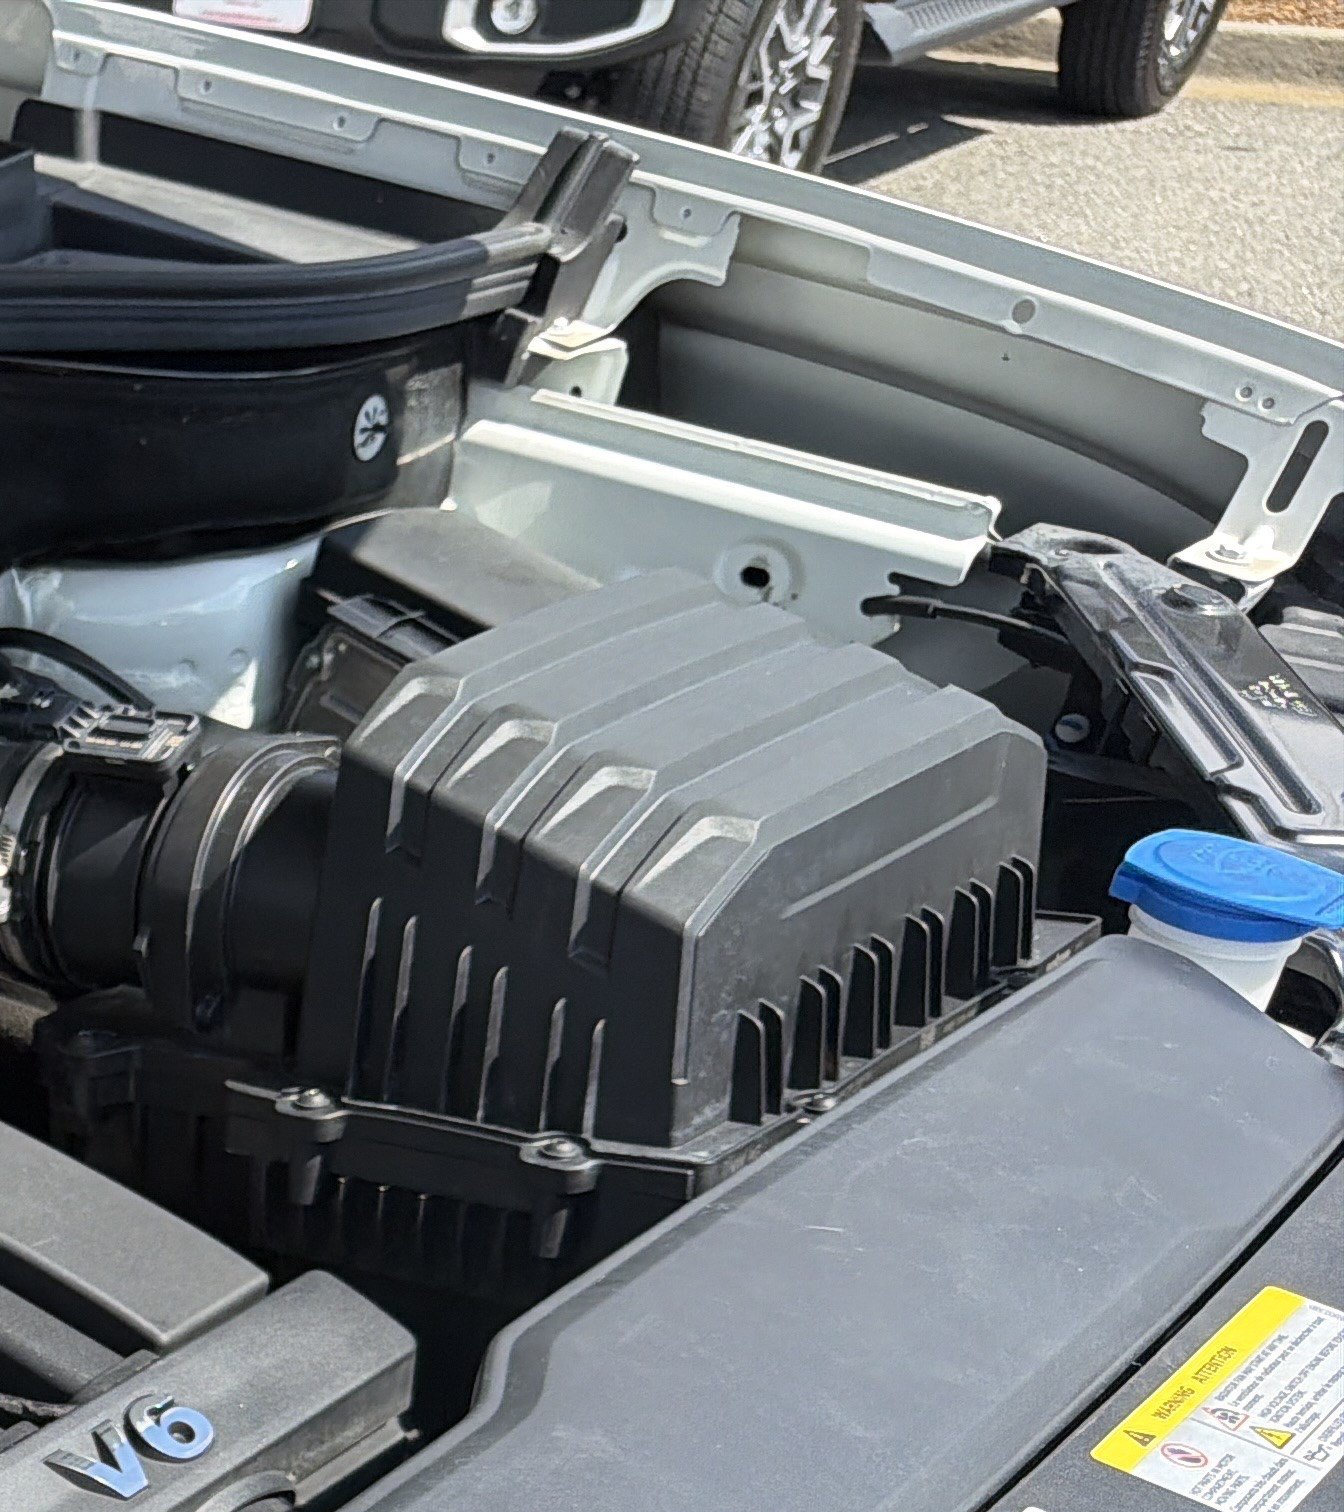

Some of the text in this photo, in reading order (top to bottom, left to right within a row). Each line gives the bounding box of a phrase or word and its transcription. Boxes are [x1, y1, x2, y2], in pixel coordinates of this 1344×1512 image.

[1152, 1386, 1195, 1420] WARNING
[1190, 1345, 1237, 1383] ATTENTION
[43, 1395, 213, 1500] V6
